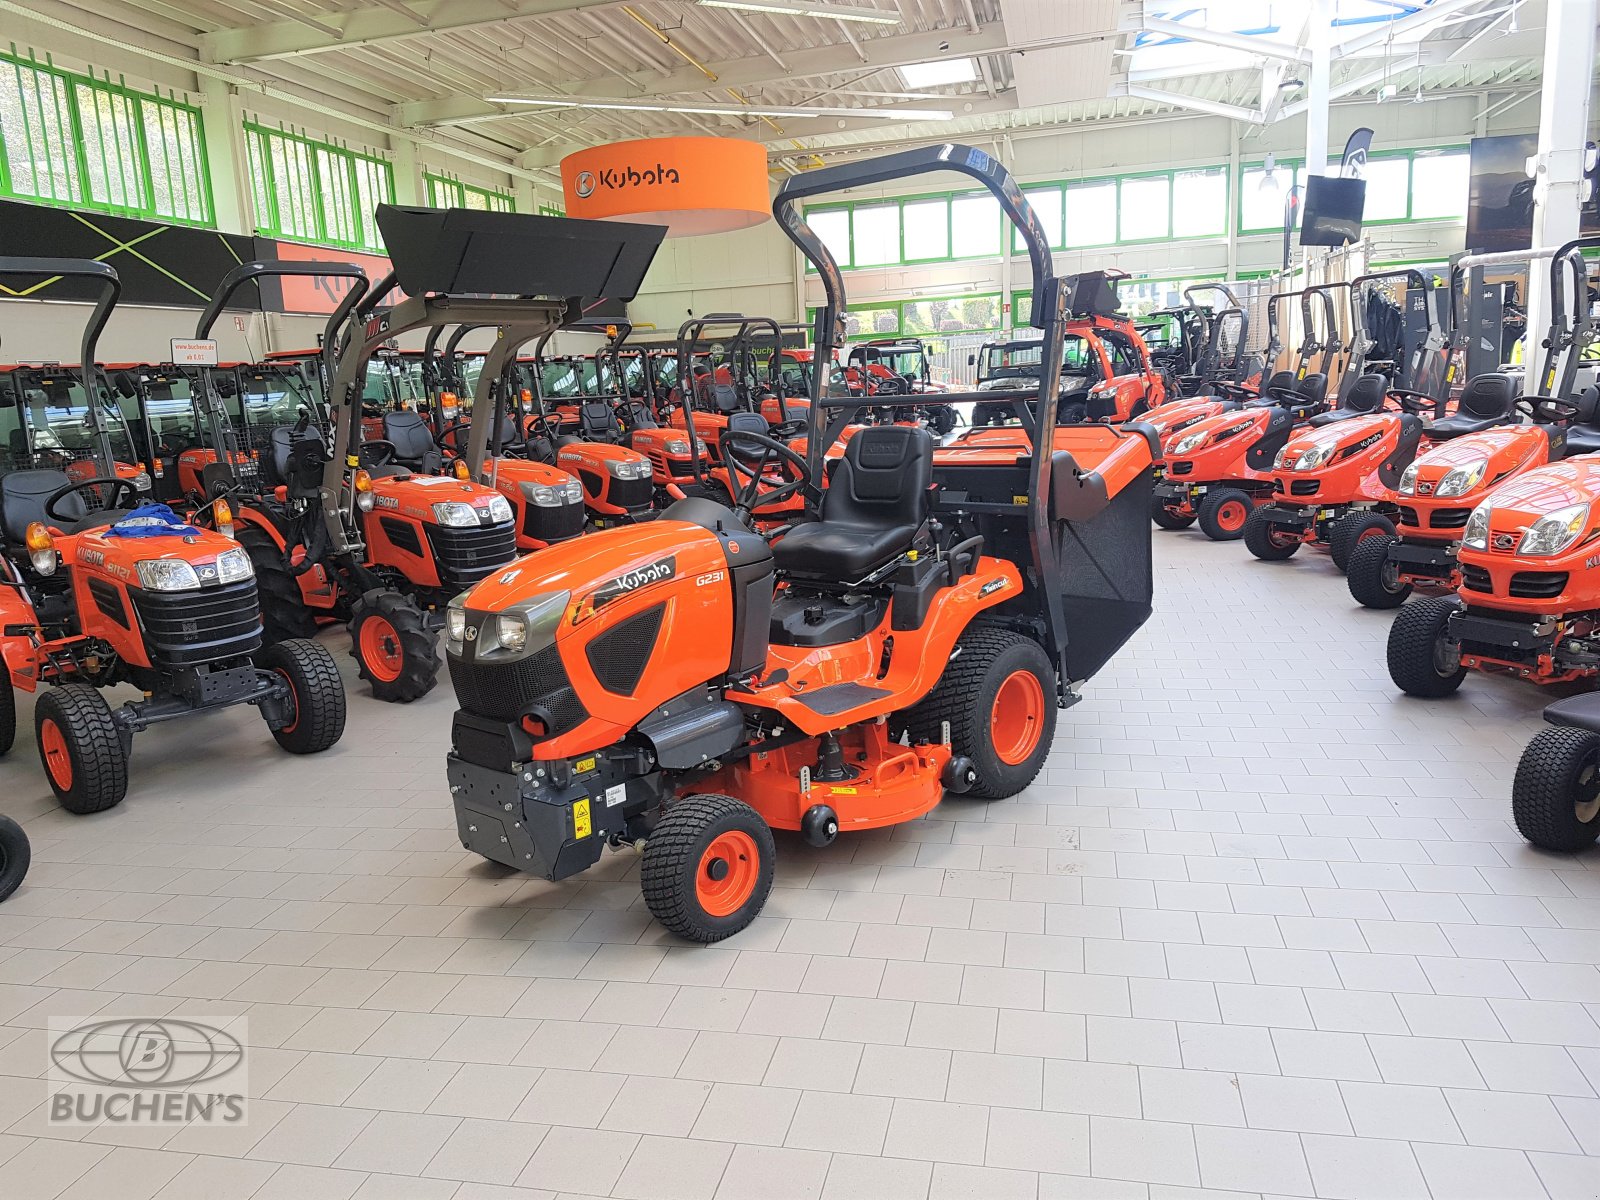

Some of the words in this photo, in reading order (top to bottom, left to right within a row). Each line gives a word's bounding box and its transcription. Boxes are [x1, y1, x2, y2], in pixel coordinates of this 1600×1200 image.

[600, 163, 679, 189] Kubota
[1232, 420, 1253, 433] Kubota
[1360, 433, 1382, 448] Kubota
[560, 452, 582, 461] KUBOTA
[374, 495, 399, 508] UBOTA
[77, 545, 105, 566] KUBOTA
[616, 563, 671, 590] Kubota
[696, 571, 724, 587] G231
